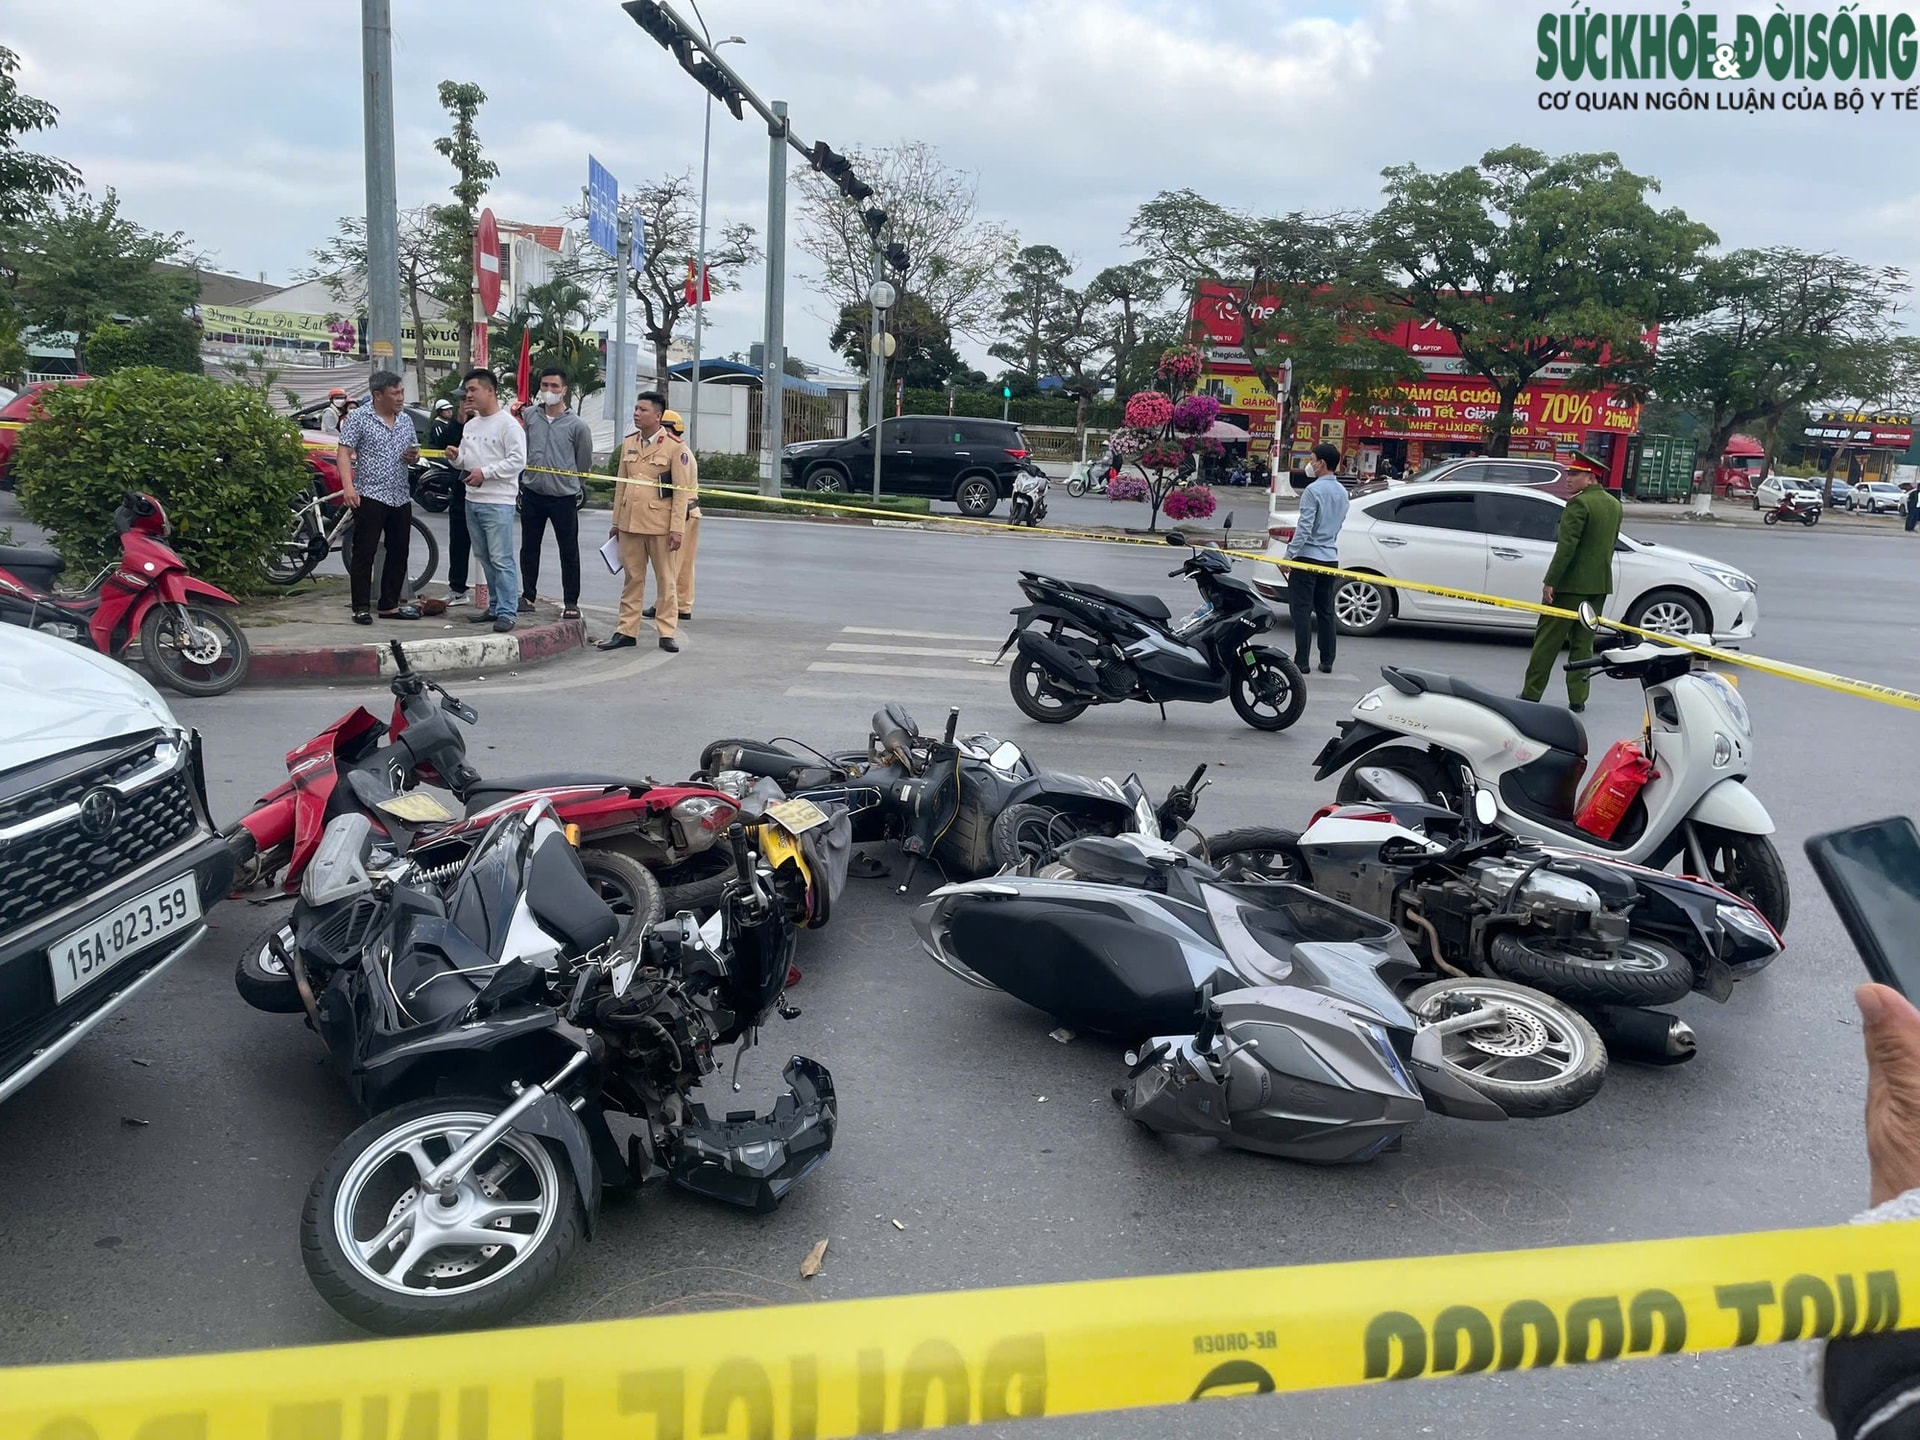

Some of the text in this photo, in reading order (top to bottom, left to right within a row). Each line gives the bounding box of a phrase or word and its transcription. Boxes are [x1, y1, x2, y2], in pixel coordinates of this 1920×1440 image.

[1433, 386, 1458, 402] GIÁ
[1540, 393, 1593, 425] 70%
[1876, 415, 1909, 425] CAR
[66, 888, 188, 981] 15A-823.59
